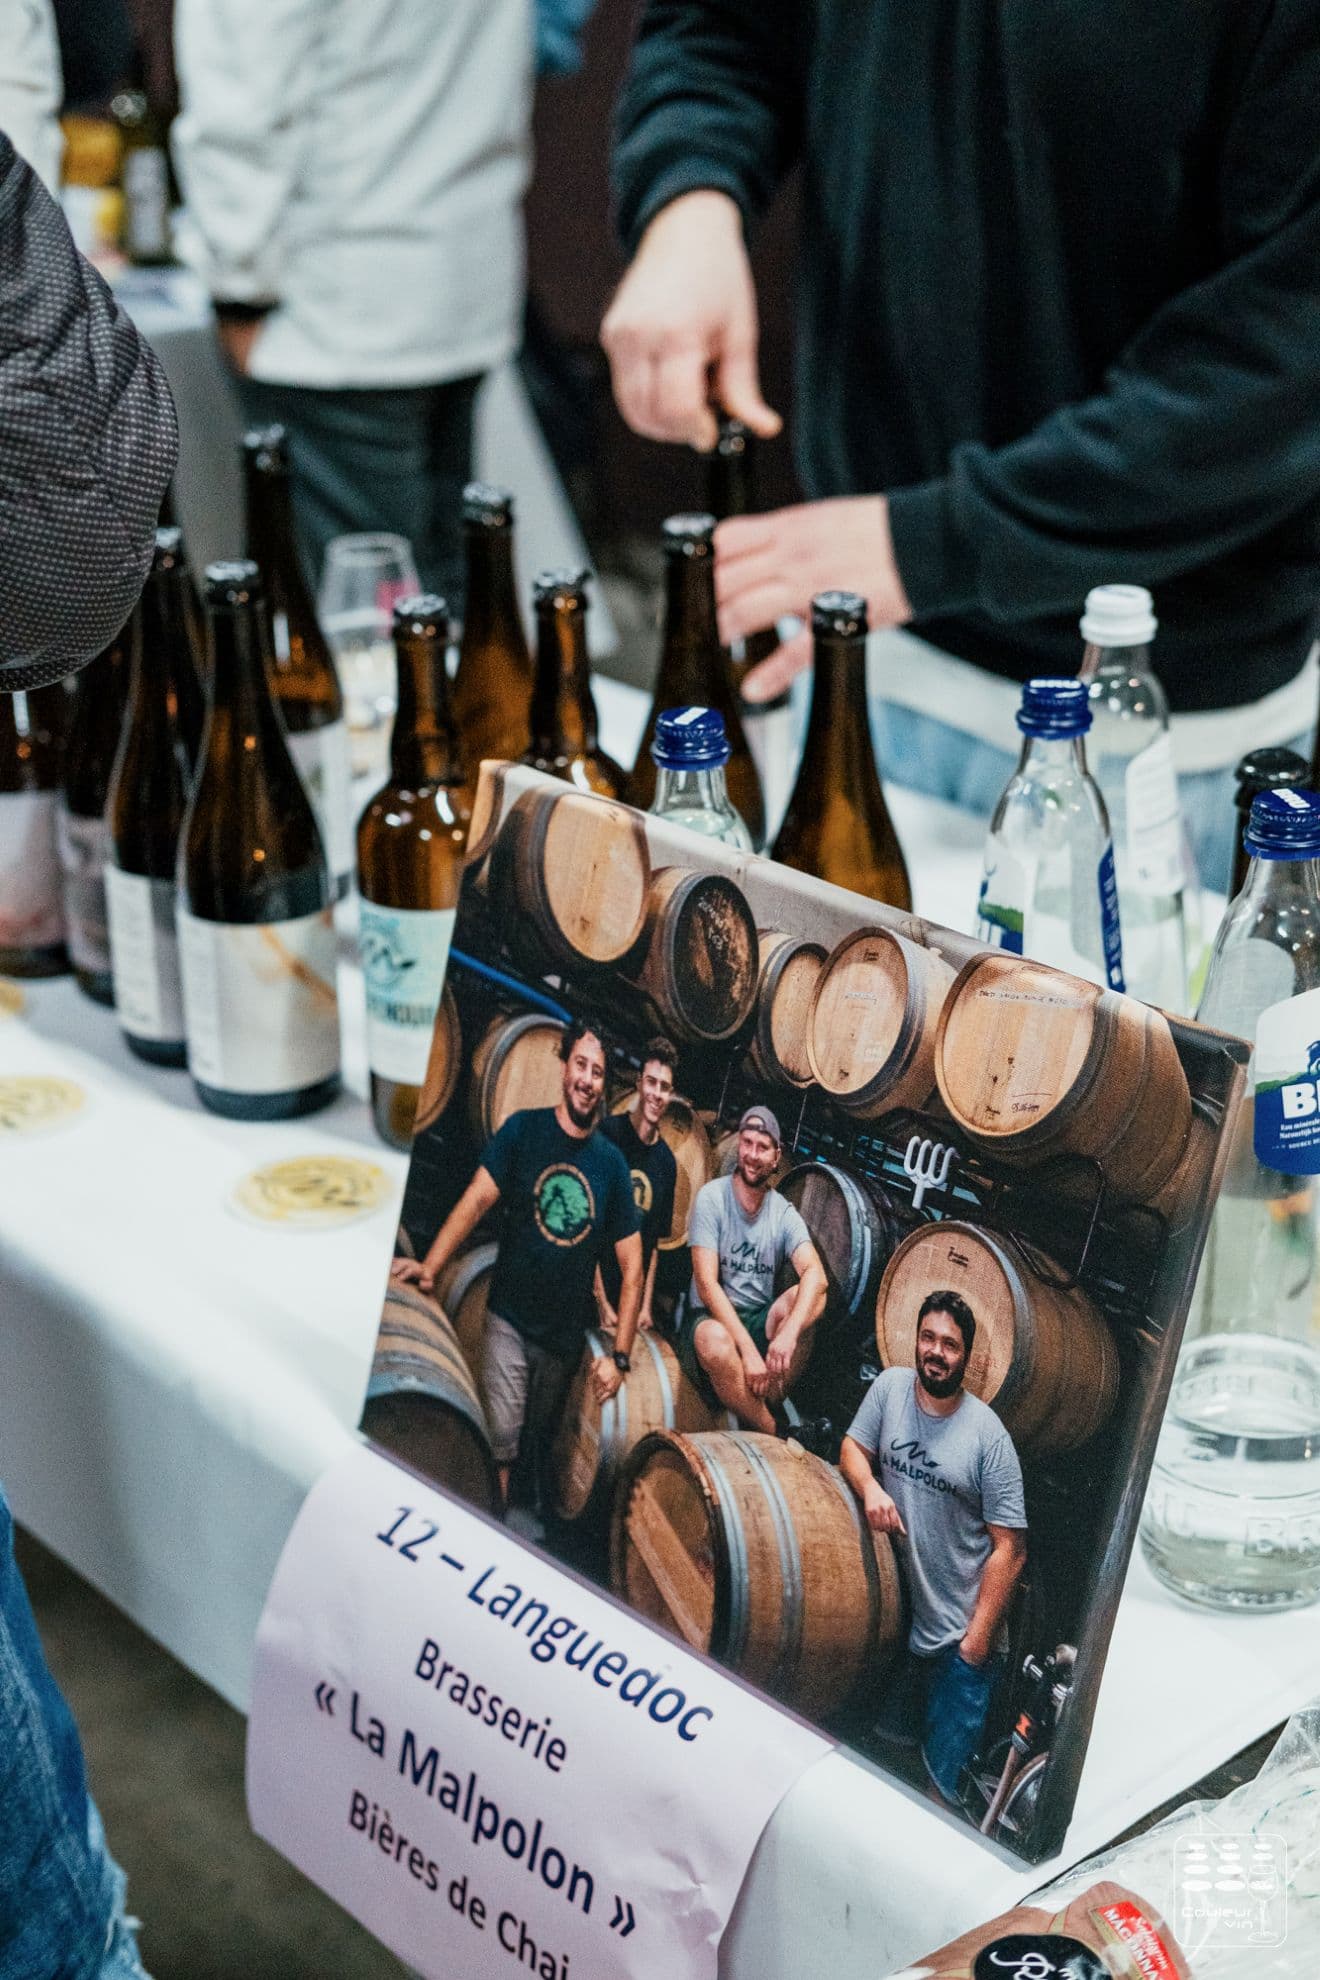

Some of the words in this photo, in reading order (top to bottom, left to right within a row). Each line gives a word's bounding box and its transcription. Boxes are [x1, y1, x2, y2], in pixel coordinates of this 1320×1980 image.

[1281, 1078, 1320, 1119] B
[376, 1507, 440, 1562] 12
[467, 1566, 713, 1743] Languedoc
[415, 1638, 567, 1773] Brasserie
[350, 1789, 439, 1892] Bières
[448, 1874, 487, 1931] de
[497, 1910, 570, 1980] Chai
[351, 1690, 386, 1759] La
[399, 1728, 595, 1915] Malpolon
